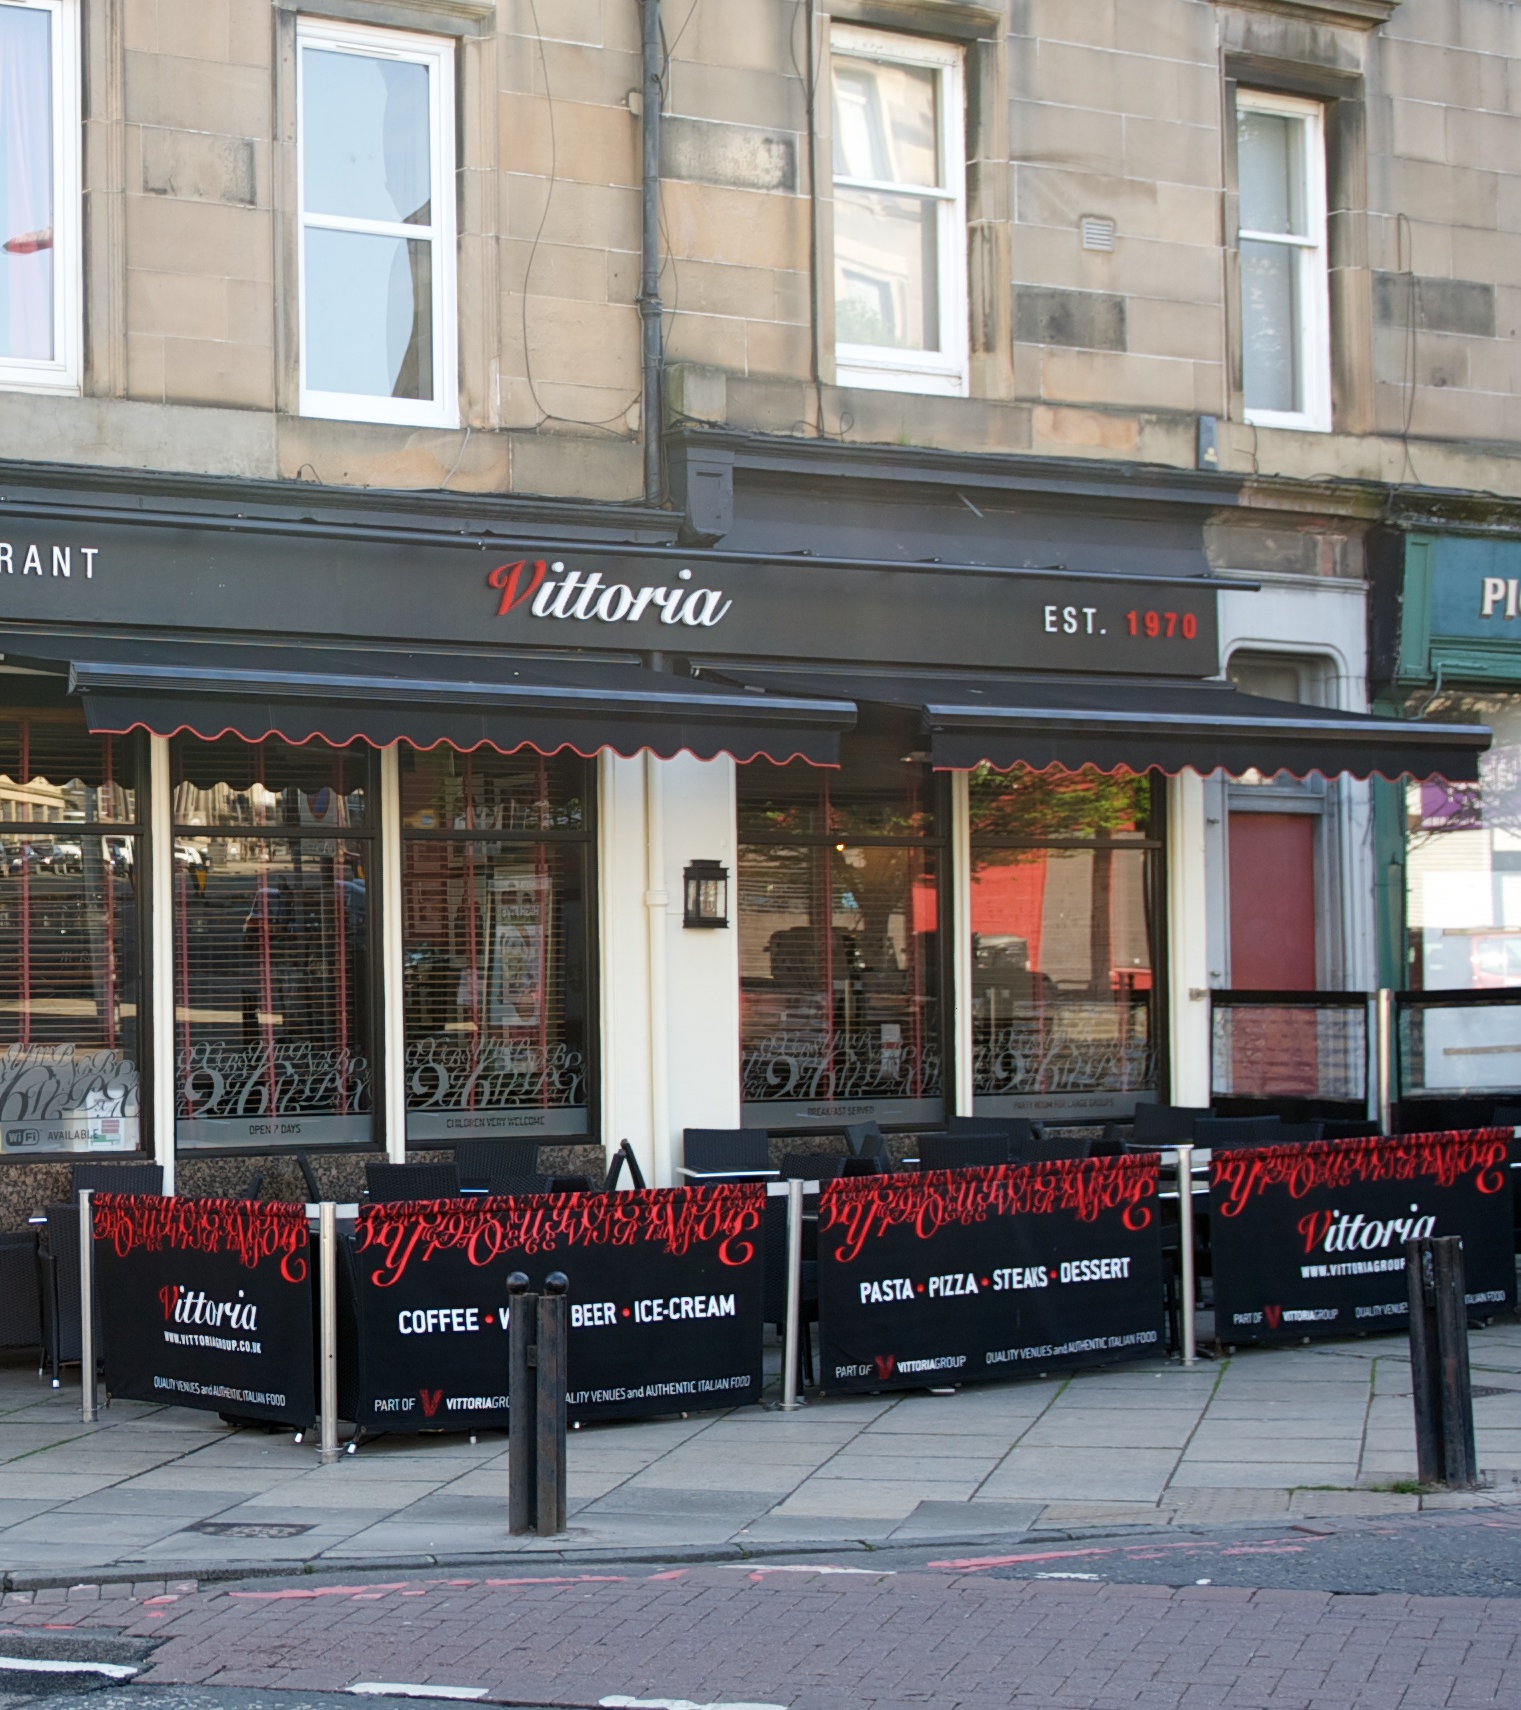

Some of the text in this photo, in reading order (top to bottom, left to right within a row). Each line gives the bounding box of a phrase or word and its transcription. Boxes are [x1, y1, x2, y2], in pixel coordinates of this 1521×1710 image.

[487, 559, 733, 627] Vittoria
[1481, 577, 1521, 617] PI
[1044, 605, 1197, 640] EST. 1970
[47, 1129, 99, 1141] AVAILABLE
[249, 1125, 271, 1135] OPEN
[281, 1124, 302, 1134] DAYS
[1297, 1203, 1437, 1254] Vittoria
[860, 1257, 1131, 1304] PASTA PIZZA STEAKS DESSERT
[1300, 1257, 1407, 1279] WWW.VITTORIAGROUP
[158, 1284, 258, 1331] Vittoria
[398, 1308, 480, 1334] COFFEE
[571, 1302, 618, 1328] BEER
[634, 1293, 736, 1323] ICE-CREAM
[835, 1364, 858, 1379] PART
[858, 1364, 874, 1376] OF
[896, 1355, 967, 1373] VITTORIAGROUP
[985, 1349, 1019, 1365] QUALITY
[1019, 1344, 1052, 1359] VENUES
[1067, 1336, 1108, 1353] AUTHENTIC
[1108, 1334, 1136, 1348] ITALIAN
[1136, 1330, 1158, 1344] FOOD
[153, 1375, 176, 1390] QUALITY
[176, 1379, 200, 1395] VENUES
[201, 1384, 213, 1396] and
[266, 1393, 286, 1407] FOOD
[374, 1399, 400, 1412] PART
[401, 1398, 417, 1411] OF
[445, 1396, 510, 1411] VITTORIAGR
[565, 1391, 590, 1405] ALITY
[590, 1387, 626, 1403] VENUES
[627, 1386, 645, 1399] and
[645, 1380, 697, 1397] AUTHENTIC
[697, 1377, 729, 1393] ITALIAN
[730, 1375, 751, 1389] FOOD
